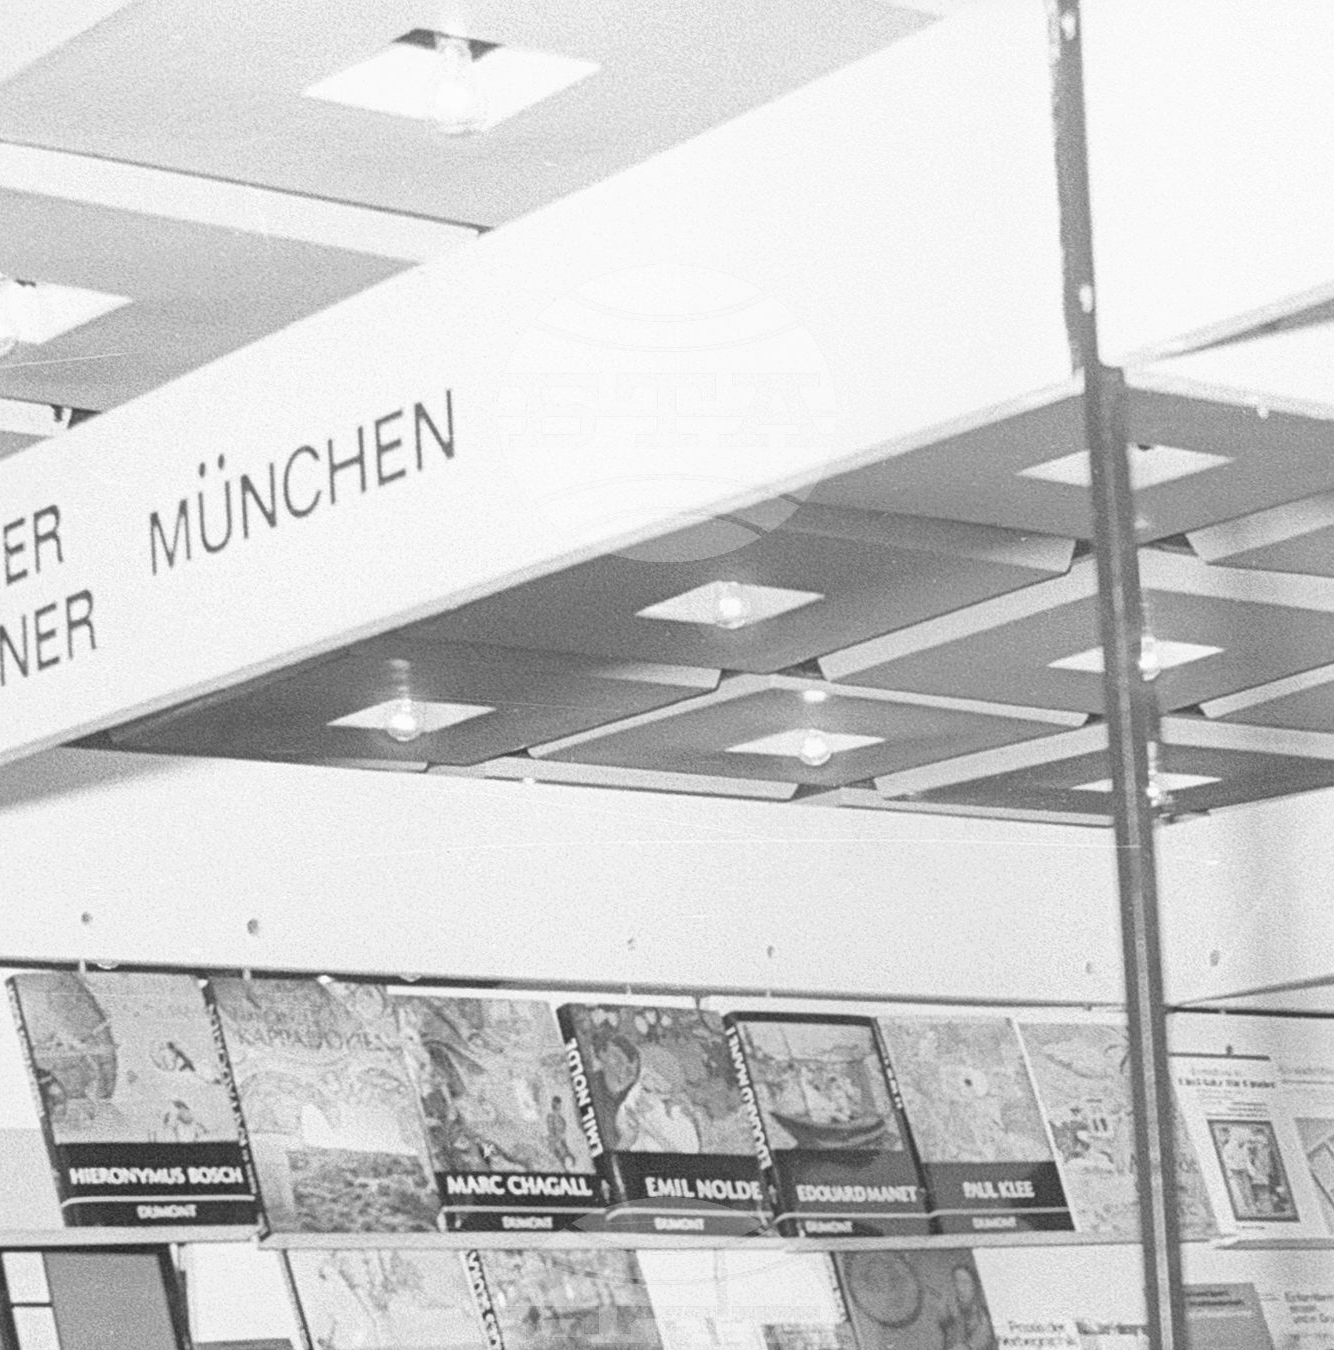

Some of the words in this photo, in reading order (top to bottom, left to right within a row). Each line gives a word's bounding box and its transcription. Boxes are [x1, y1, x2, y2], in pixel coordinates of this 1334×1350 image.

[149, 390, 457, 575] MÜNCHEN
[69, 1167, 185, 1187] HIERONYMUS
[188, 1166, 244, 1186] BOSCH
[447, 1177, 505, 1197] MARC
[508, 1176, 593, 1198] CHAGALL
[646, 1178, 695, 1199] EMIL
[697, 1179, 763, 1201] NOLDE
[796, 1184, 867, 1203] EDOUARD
[962, 1181, 996, 1199] PAUL
[998, 1181, 1035, 1199] KLEE
[136, 1203, 197, 1220] DUMONT
[654, 1217, 706, 1232] DUMONT
